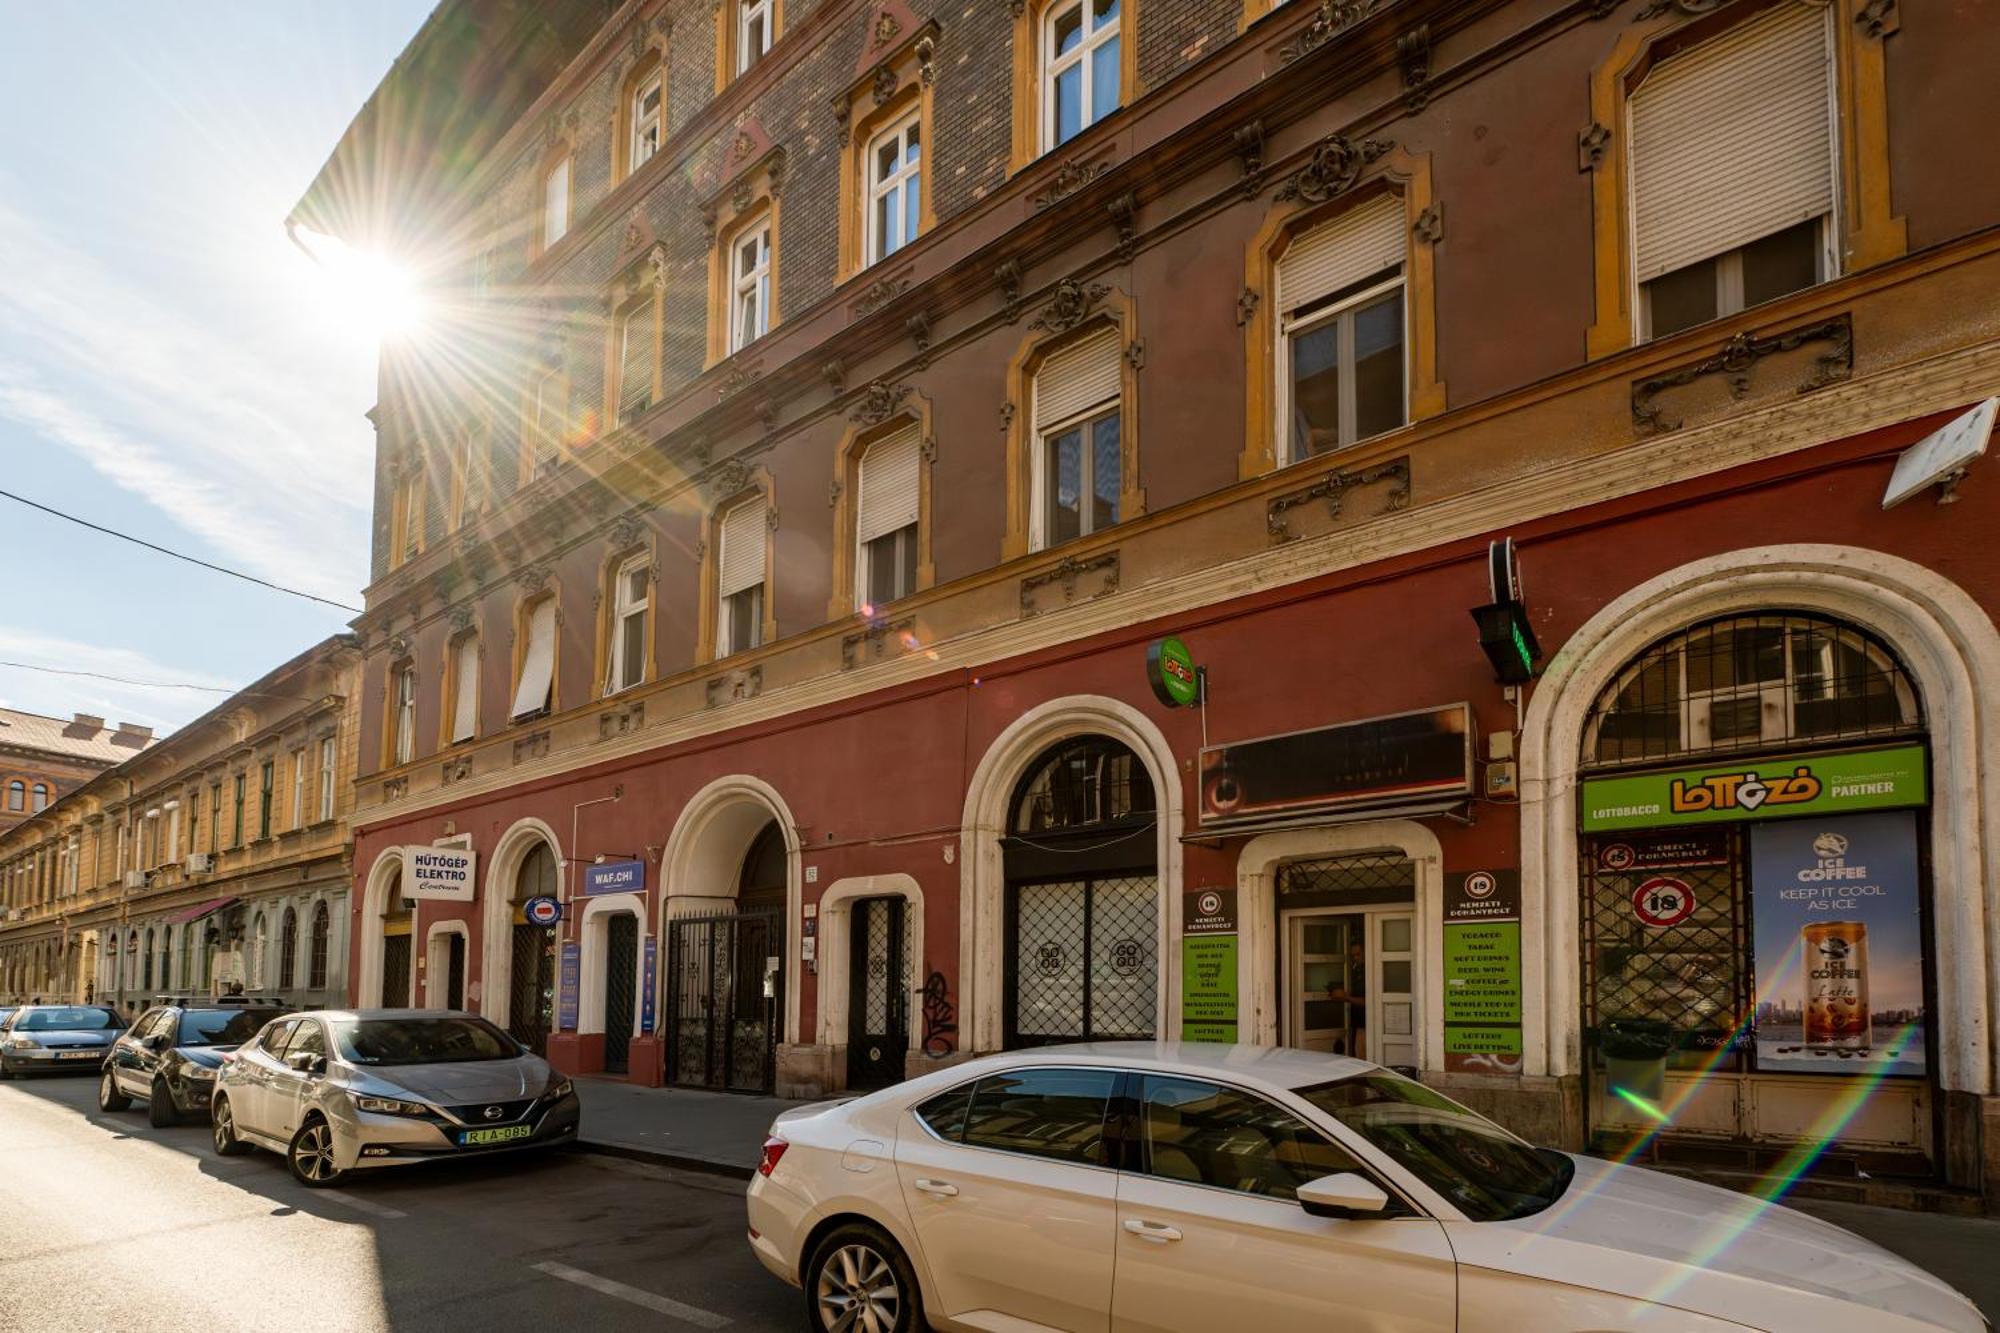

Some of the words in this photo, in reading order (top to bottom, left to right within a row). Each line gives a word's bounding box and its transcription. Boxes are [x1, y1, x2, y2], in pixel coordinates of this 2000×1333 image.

[1830, 781, 1894, 798] PARTNER
[1592, 803, 1660, 820] LOTTOBACCO
[415, 853, 469, 869] HŰTŐGÉP
[1818, 858, 1844, 869] ICE
[415, 868, 467, 881] ELEKTRO
[1797, 866, 1867, 881] COFFEE
[1473, 881, 1488, 890] 18
[1780, 888, 1818, 900] KEEP
[1821, 887, 1836, 898] IT
[1838, 886, 1888, 897] COOL
[1652, 894, 1678, 911] 18
[1808, 900, 1829, 910] AS
[1832, 899, 1857, 909] ICE
[1825, 961, 1846, 969] ICE
[1810, 969, 1861, 979] COFFEE
[1818, 984, 1854, 997] Latte
[469, 1126, 528, 1142] RIA-085
